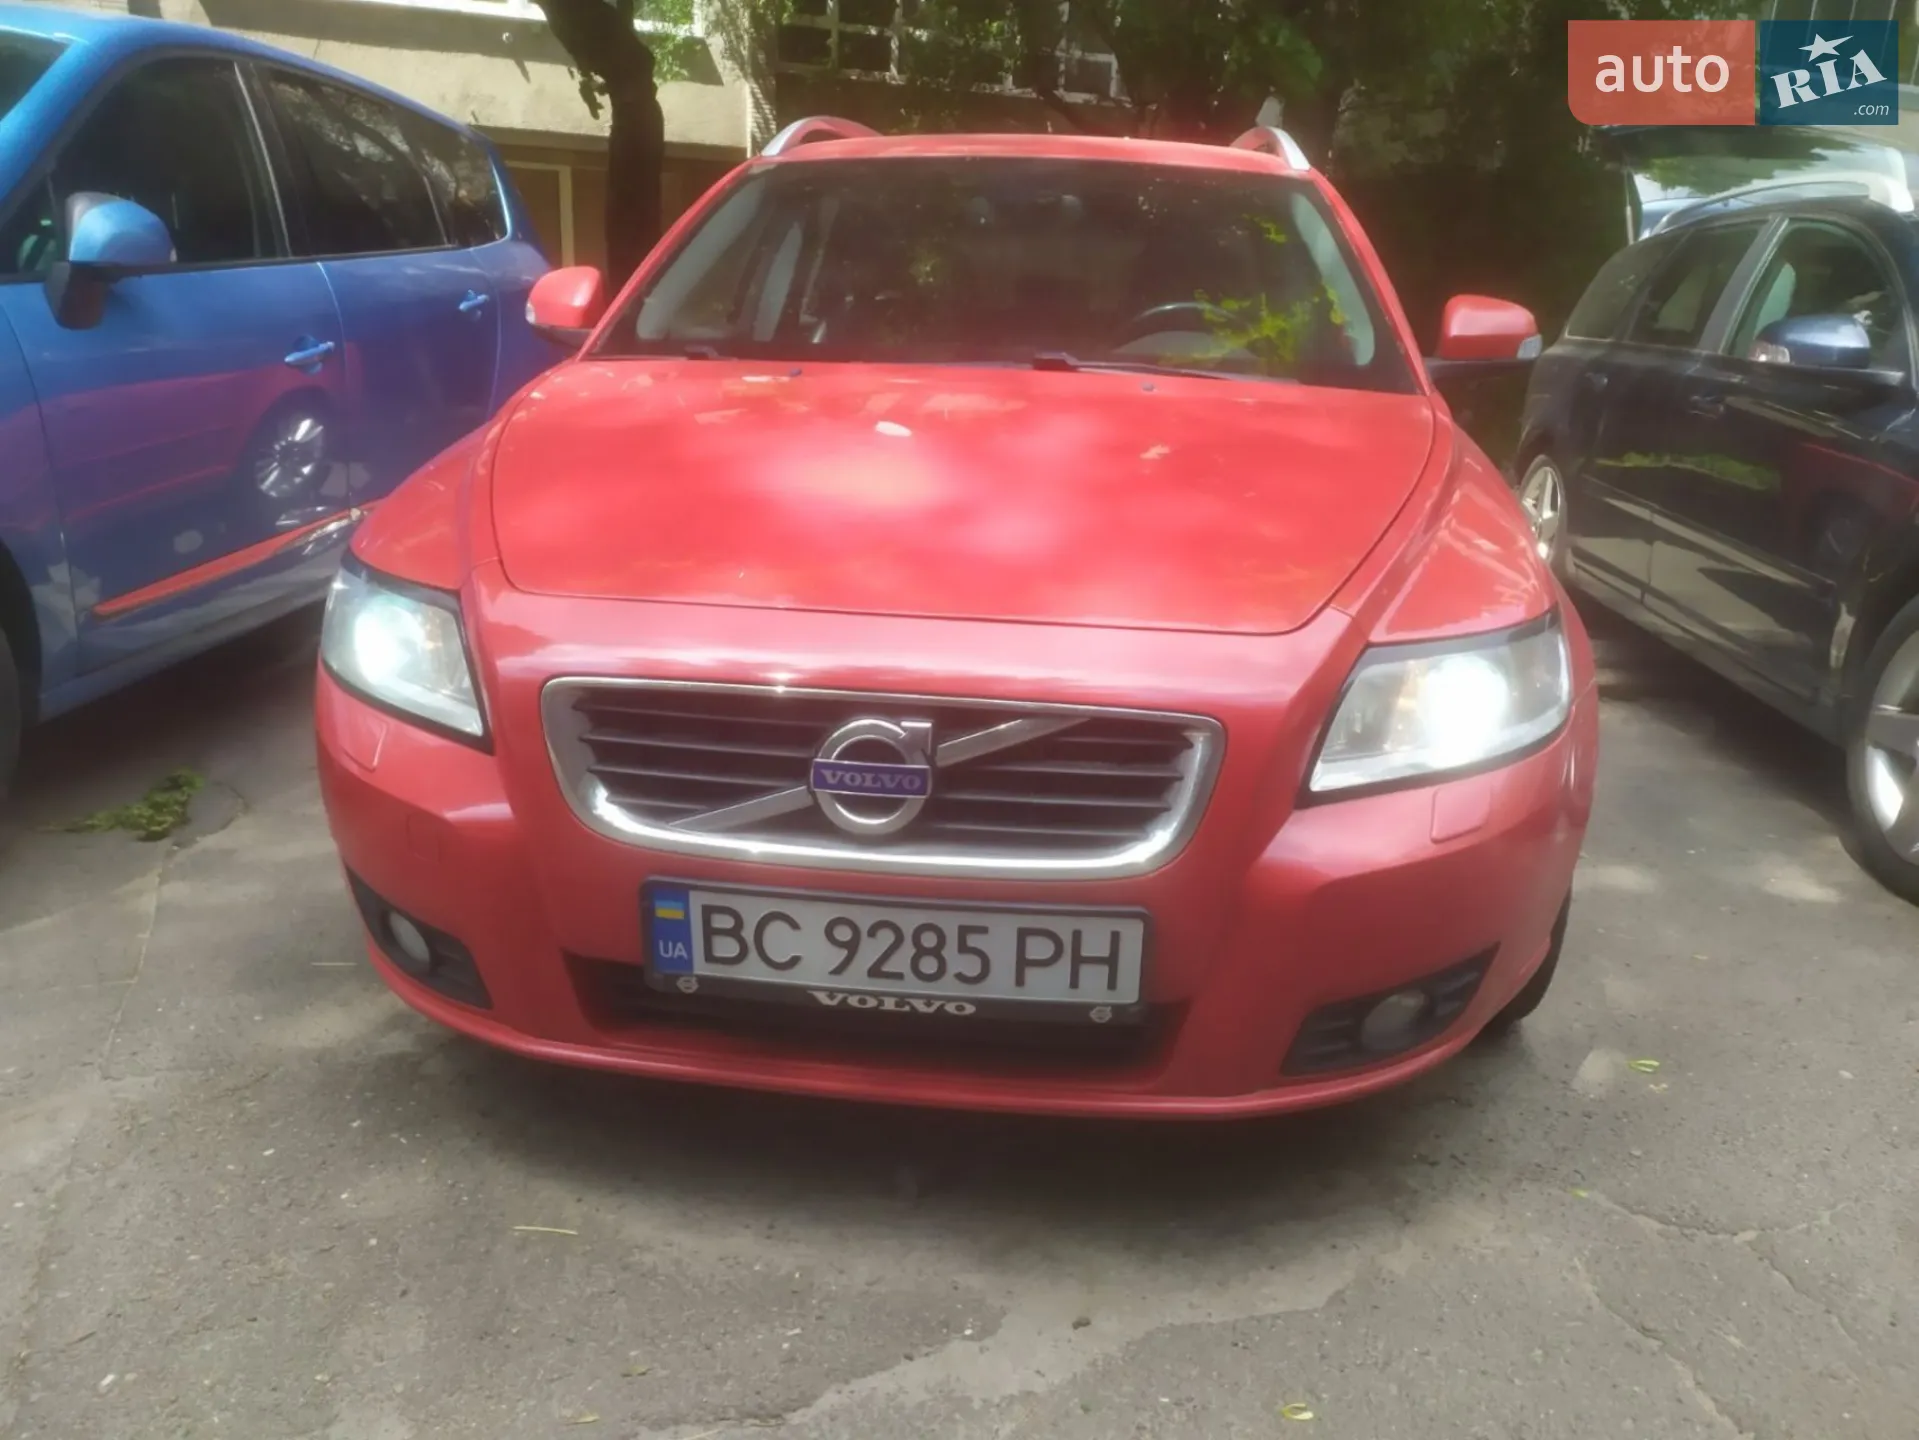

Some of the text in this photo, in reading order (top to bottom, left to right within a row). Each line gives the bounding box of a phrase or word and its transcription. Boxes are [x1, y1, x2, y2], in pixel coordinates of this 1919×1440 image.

[820, 769, 921, 790] VOLVO
[659, 941, 688, 960] UA
[701, 904, 1121, 990] BC 9285 PH
[807, 990, 977, 1016] VOLVO
